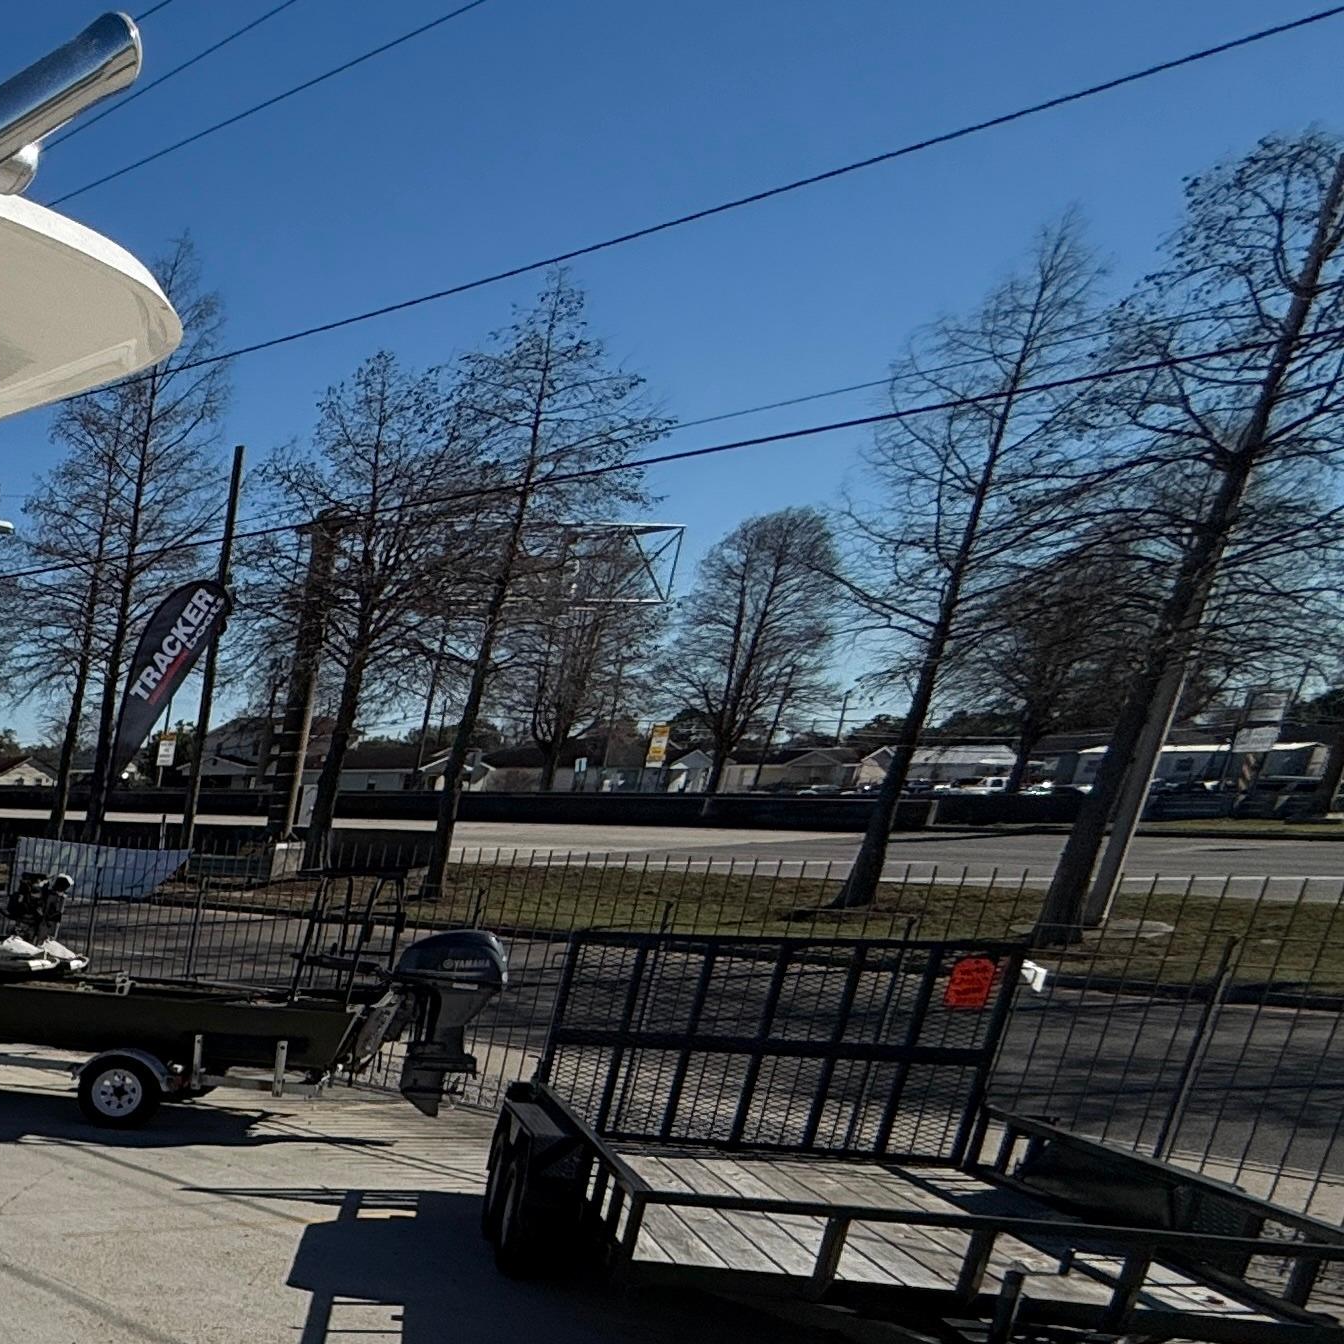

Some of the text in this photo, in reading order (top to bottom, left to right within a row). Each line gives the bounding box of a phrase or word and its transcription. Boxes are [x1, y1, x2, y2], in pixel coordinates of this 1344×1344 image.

[129, 588, 216, 700] TRACKER
[185, 597, 225, 650] boats
[454, 959, 491, 969] YAMAHA
